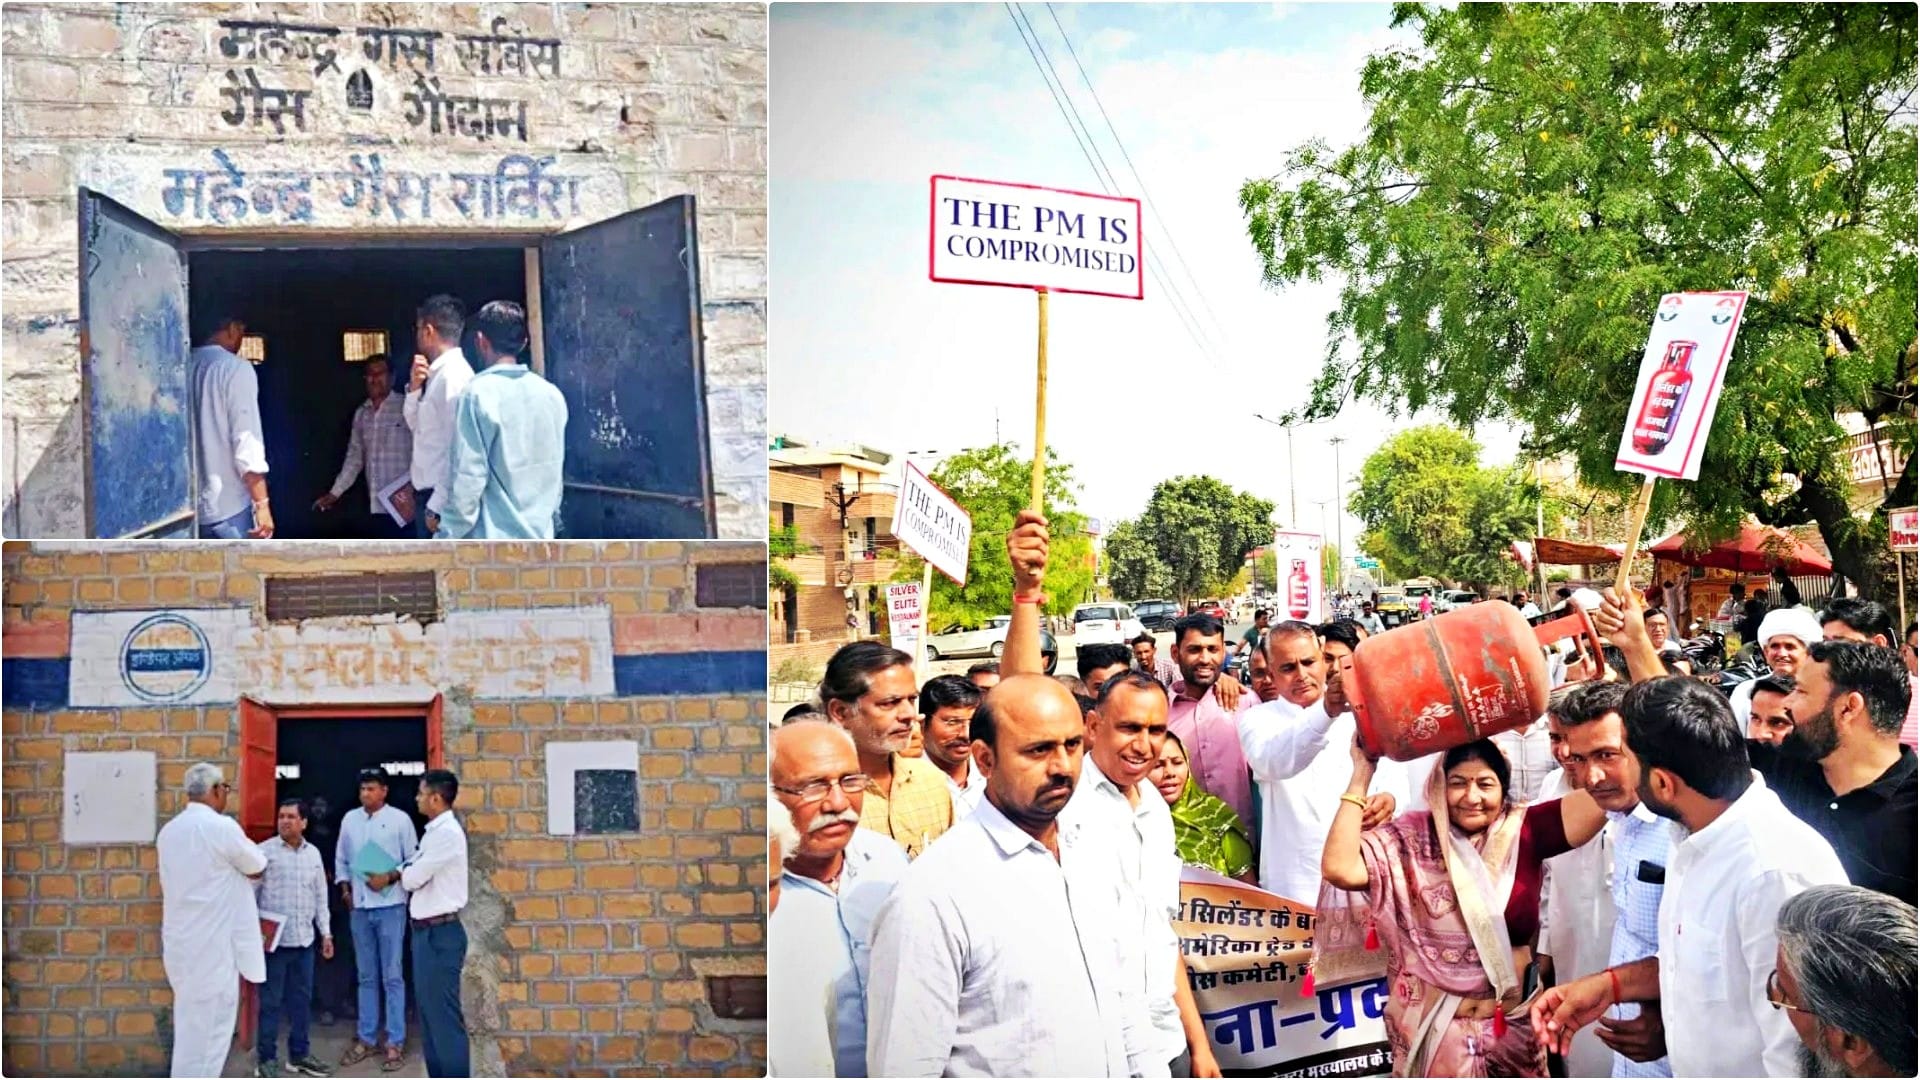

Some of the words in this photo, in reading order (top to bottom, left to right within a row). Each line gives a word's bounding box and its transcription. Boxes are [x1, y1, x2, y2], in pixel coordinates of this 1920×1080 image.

[944, 197, 1021, 231] THE
[1034, 206, 1085, 239] PM
[1098, 216, 1128, 245] IS
[947, 234, 1136, 275] COMPROMISED
[909, 480, 932, 518] THE
[934, 505, 954, 535] PM
[957, 522, 966, 545] IS
[890, 584, 918, 596] SILVER
[894, 599, 918, 610] ELITE
[1191, 898, 1266, 927] सिलेंडर
[1270, 906, 1291, 928] के
[1369, 1049, 1384, 1066] के
